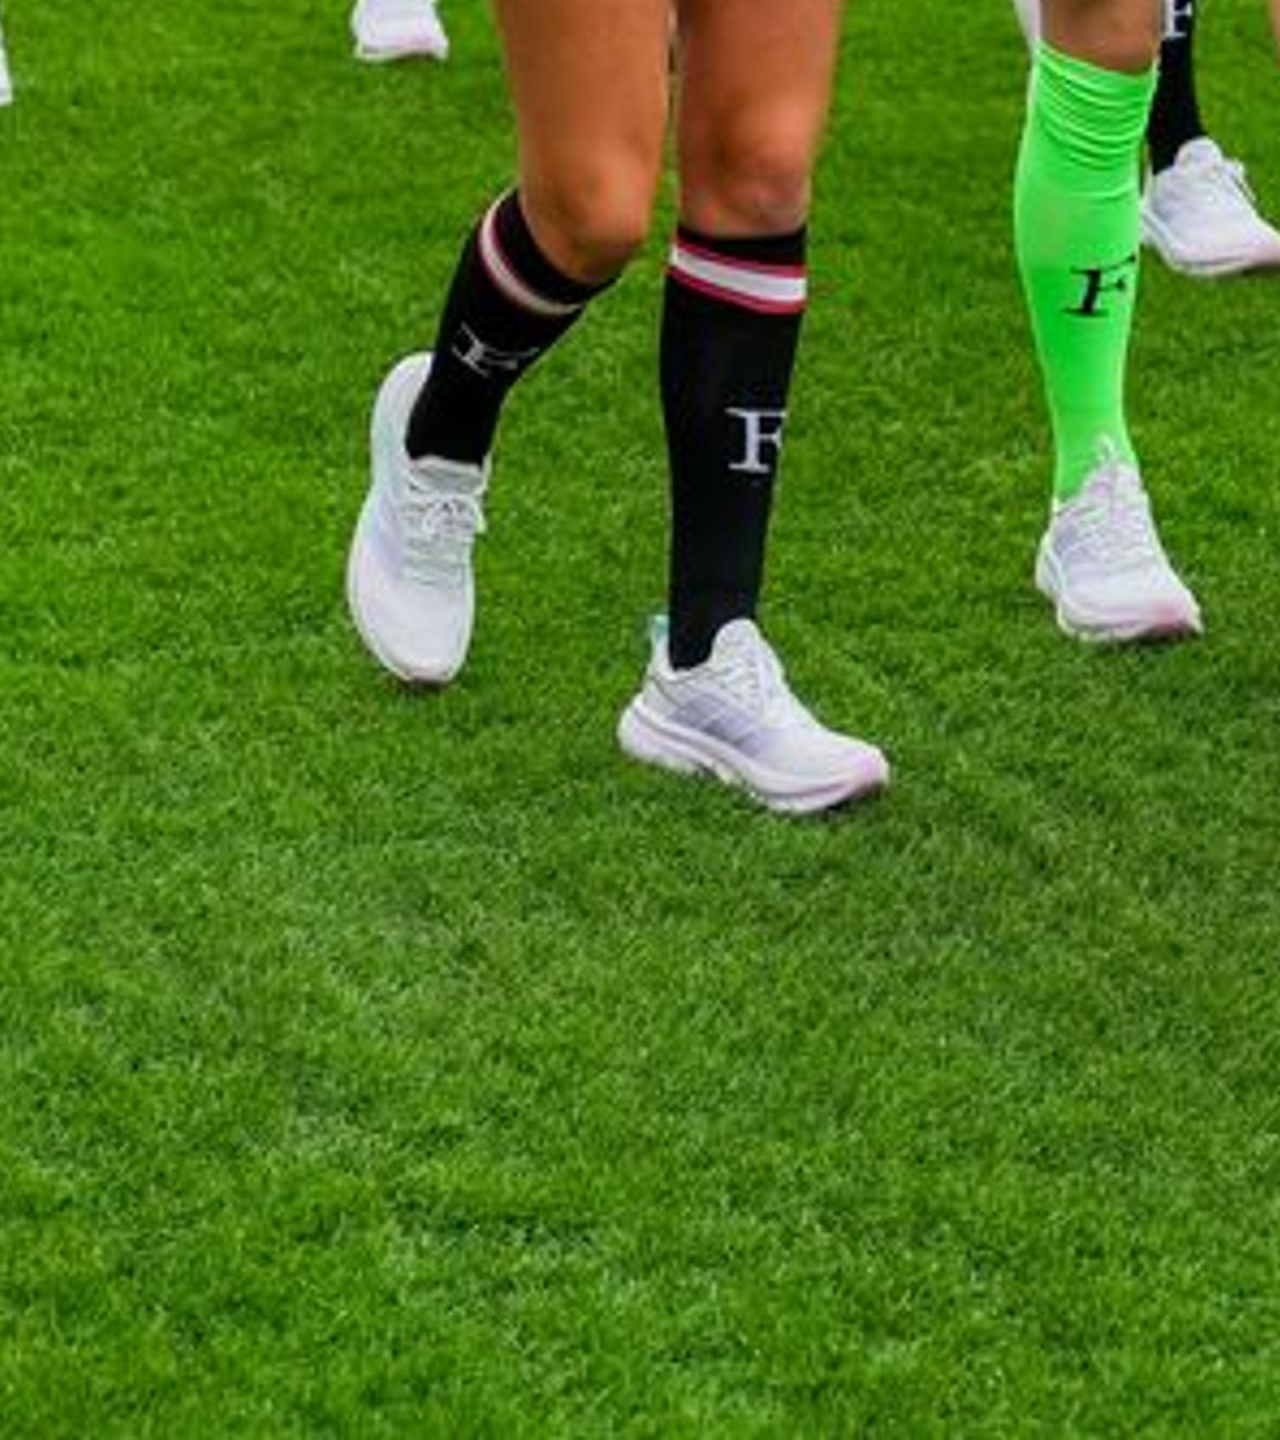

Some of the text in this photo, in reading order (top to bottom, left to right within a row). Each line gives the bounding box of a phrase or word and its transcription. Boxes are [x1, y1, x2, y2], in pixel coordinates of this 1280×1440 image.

[1063, 255, 1137, 317] F
[451, 322, 540, 379] F
[725, 406, 788, 474] F
